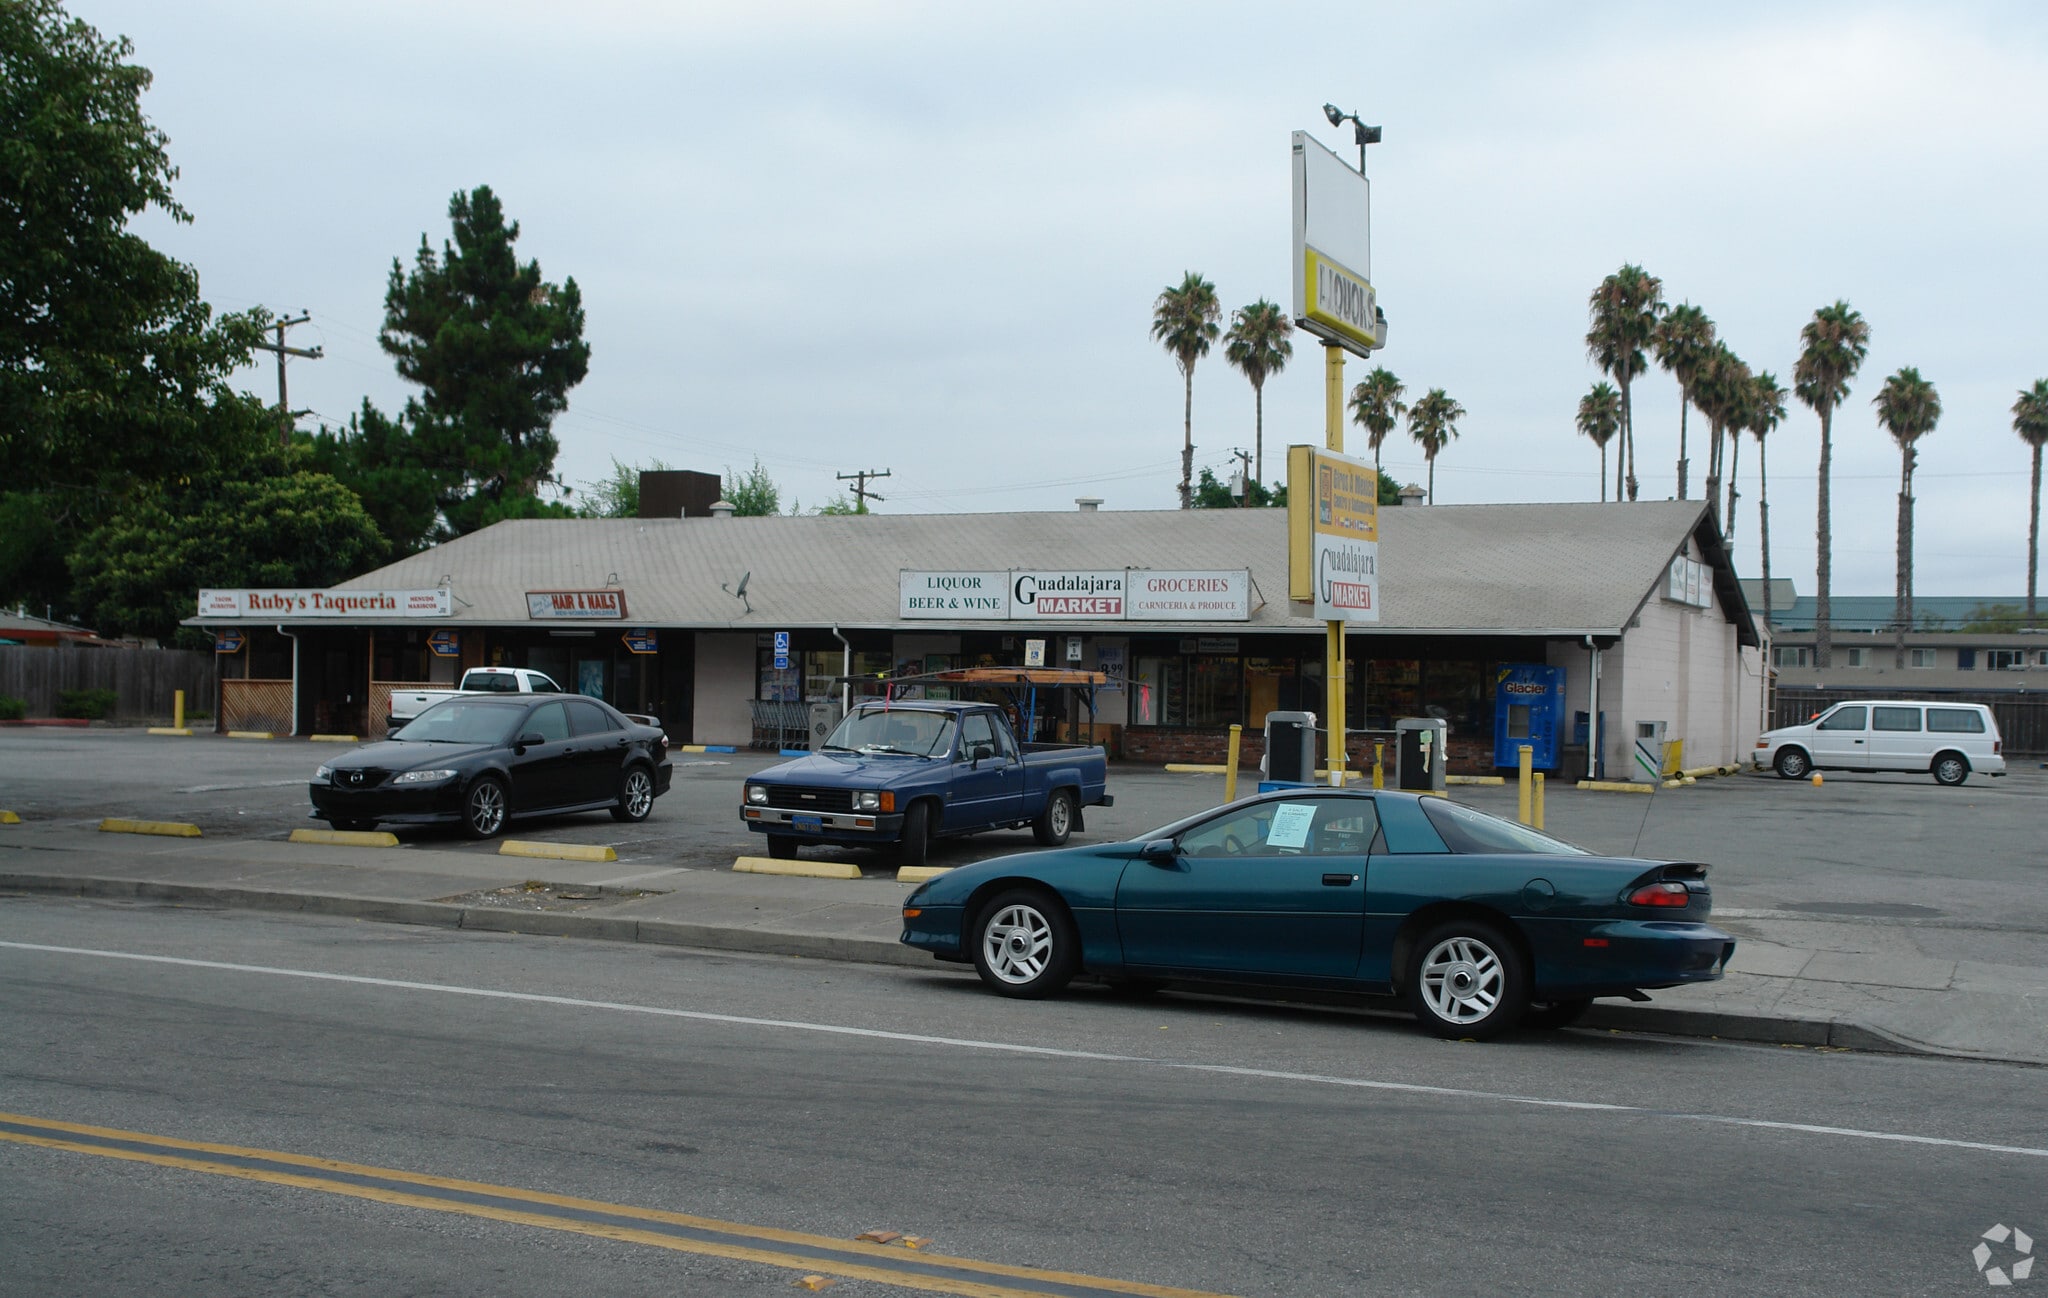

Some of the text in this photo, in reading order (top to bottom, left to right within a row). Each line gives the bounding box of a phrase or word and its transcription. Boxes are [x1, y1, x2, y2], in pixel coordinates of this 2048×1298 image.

[1320, 544, 1374, 604] Guadalajara
[927, 577, 982, 591] LIQUOR
[1014, 575, 1121, 605] Guadalajara
[1147, 578, 1229, 592] GROCERIES
[248, 592, 396, 613] Ruby's Taqueria
[551, 594, 575, 609] HAIR
[578, 593, 585, 609] &
[587, 594, 616, 610] NAILS
[909, 597, 1000, 609] BEER & WINE
[1334, 584, 1369, 608] MARKET
[1039, 598, 1120, 613] MARKET
[1138, 601, 1236, 610] CARNICERIA & PRODUCE
[1504, 682, 1548, 694] Glacier
